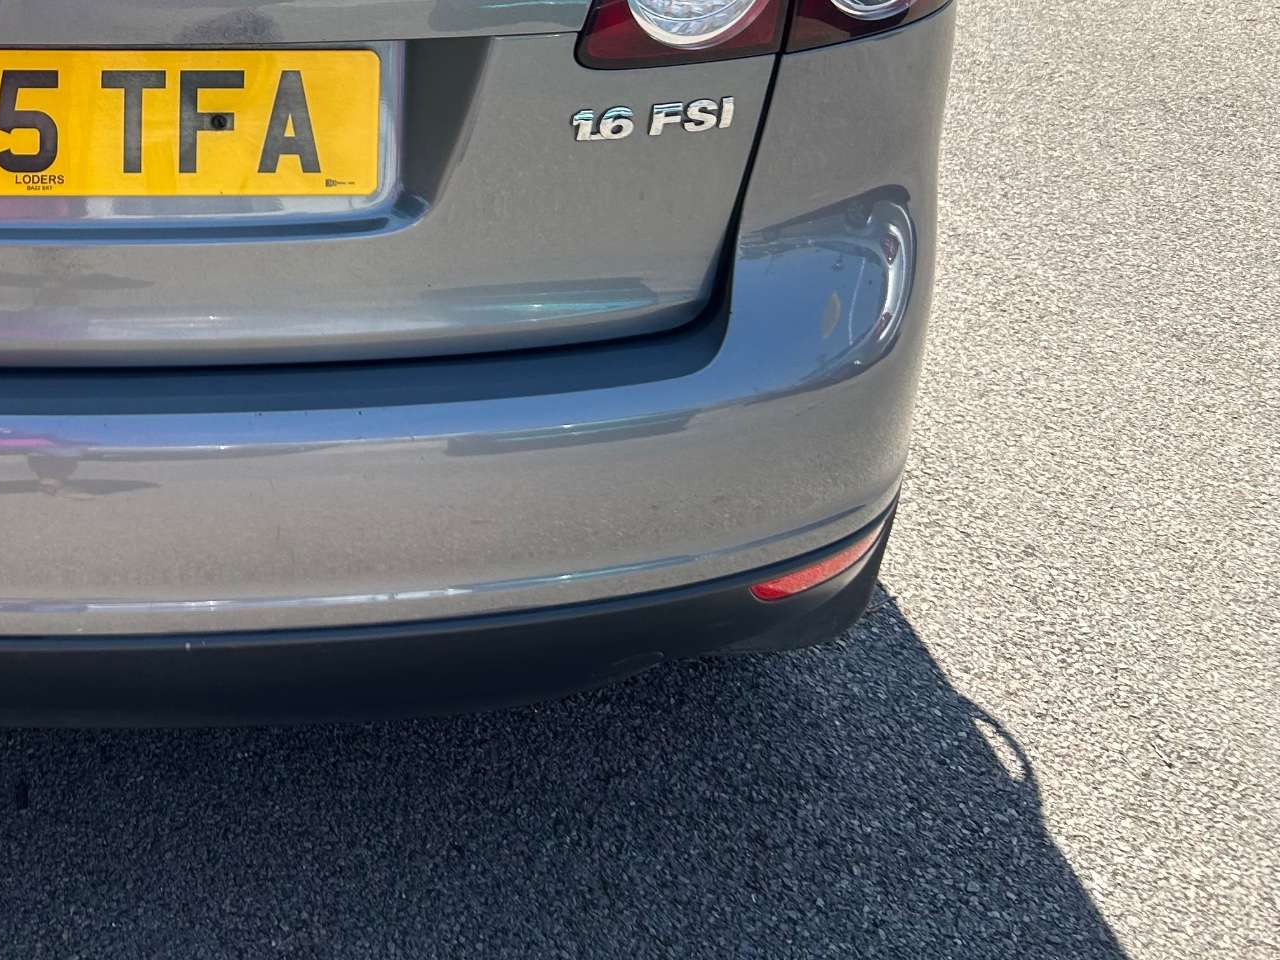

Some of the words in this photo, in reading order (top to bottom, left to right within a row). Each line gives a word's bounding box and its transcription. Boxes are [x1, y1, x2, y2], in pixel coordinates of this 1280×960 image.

[101, 68, 322, 175] TFA
[648, 96, 735, 137] FSI
[15, 174, 65, 184] LODERS
